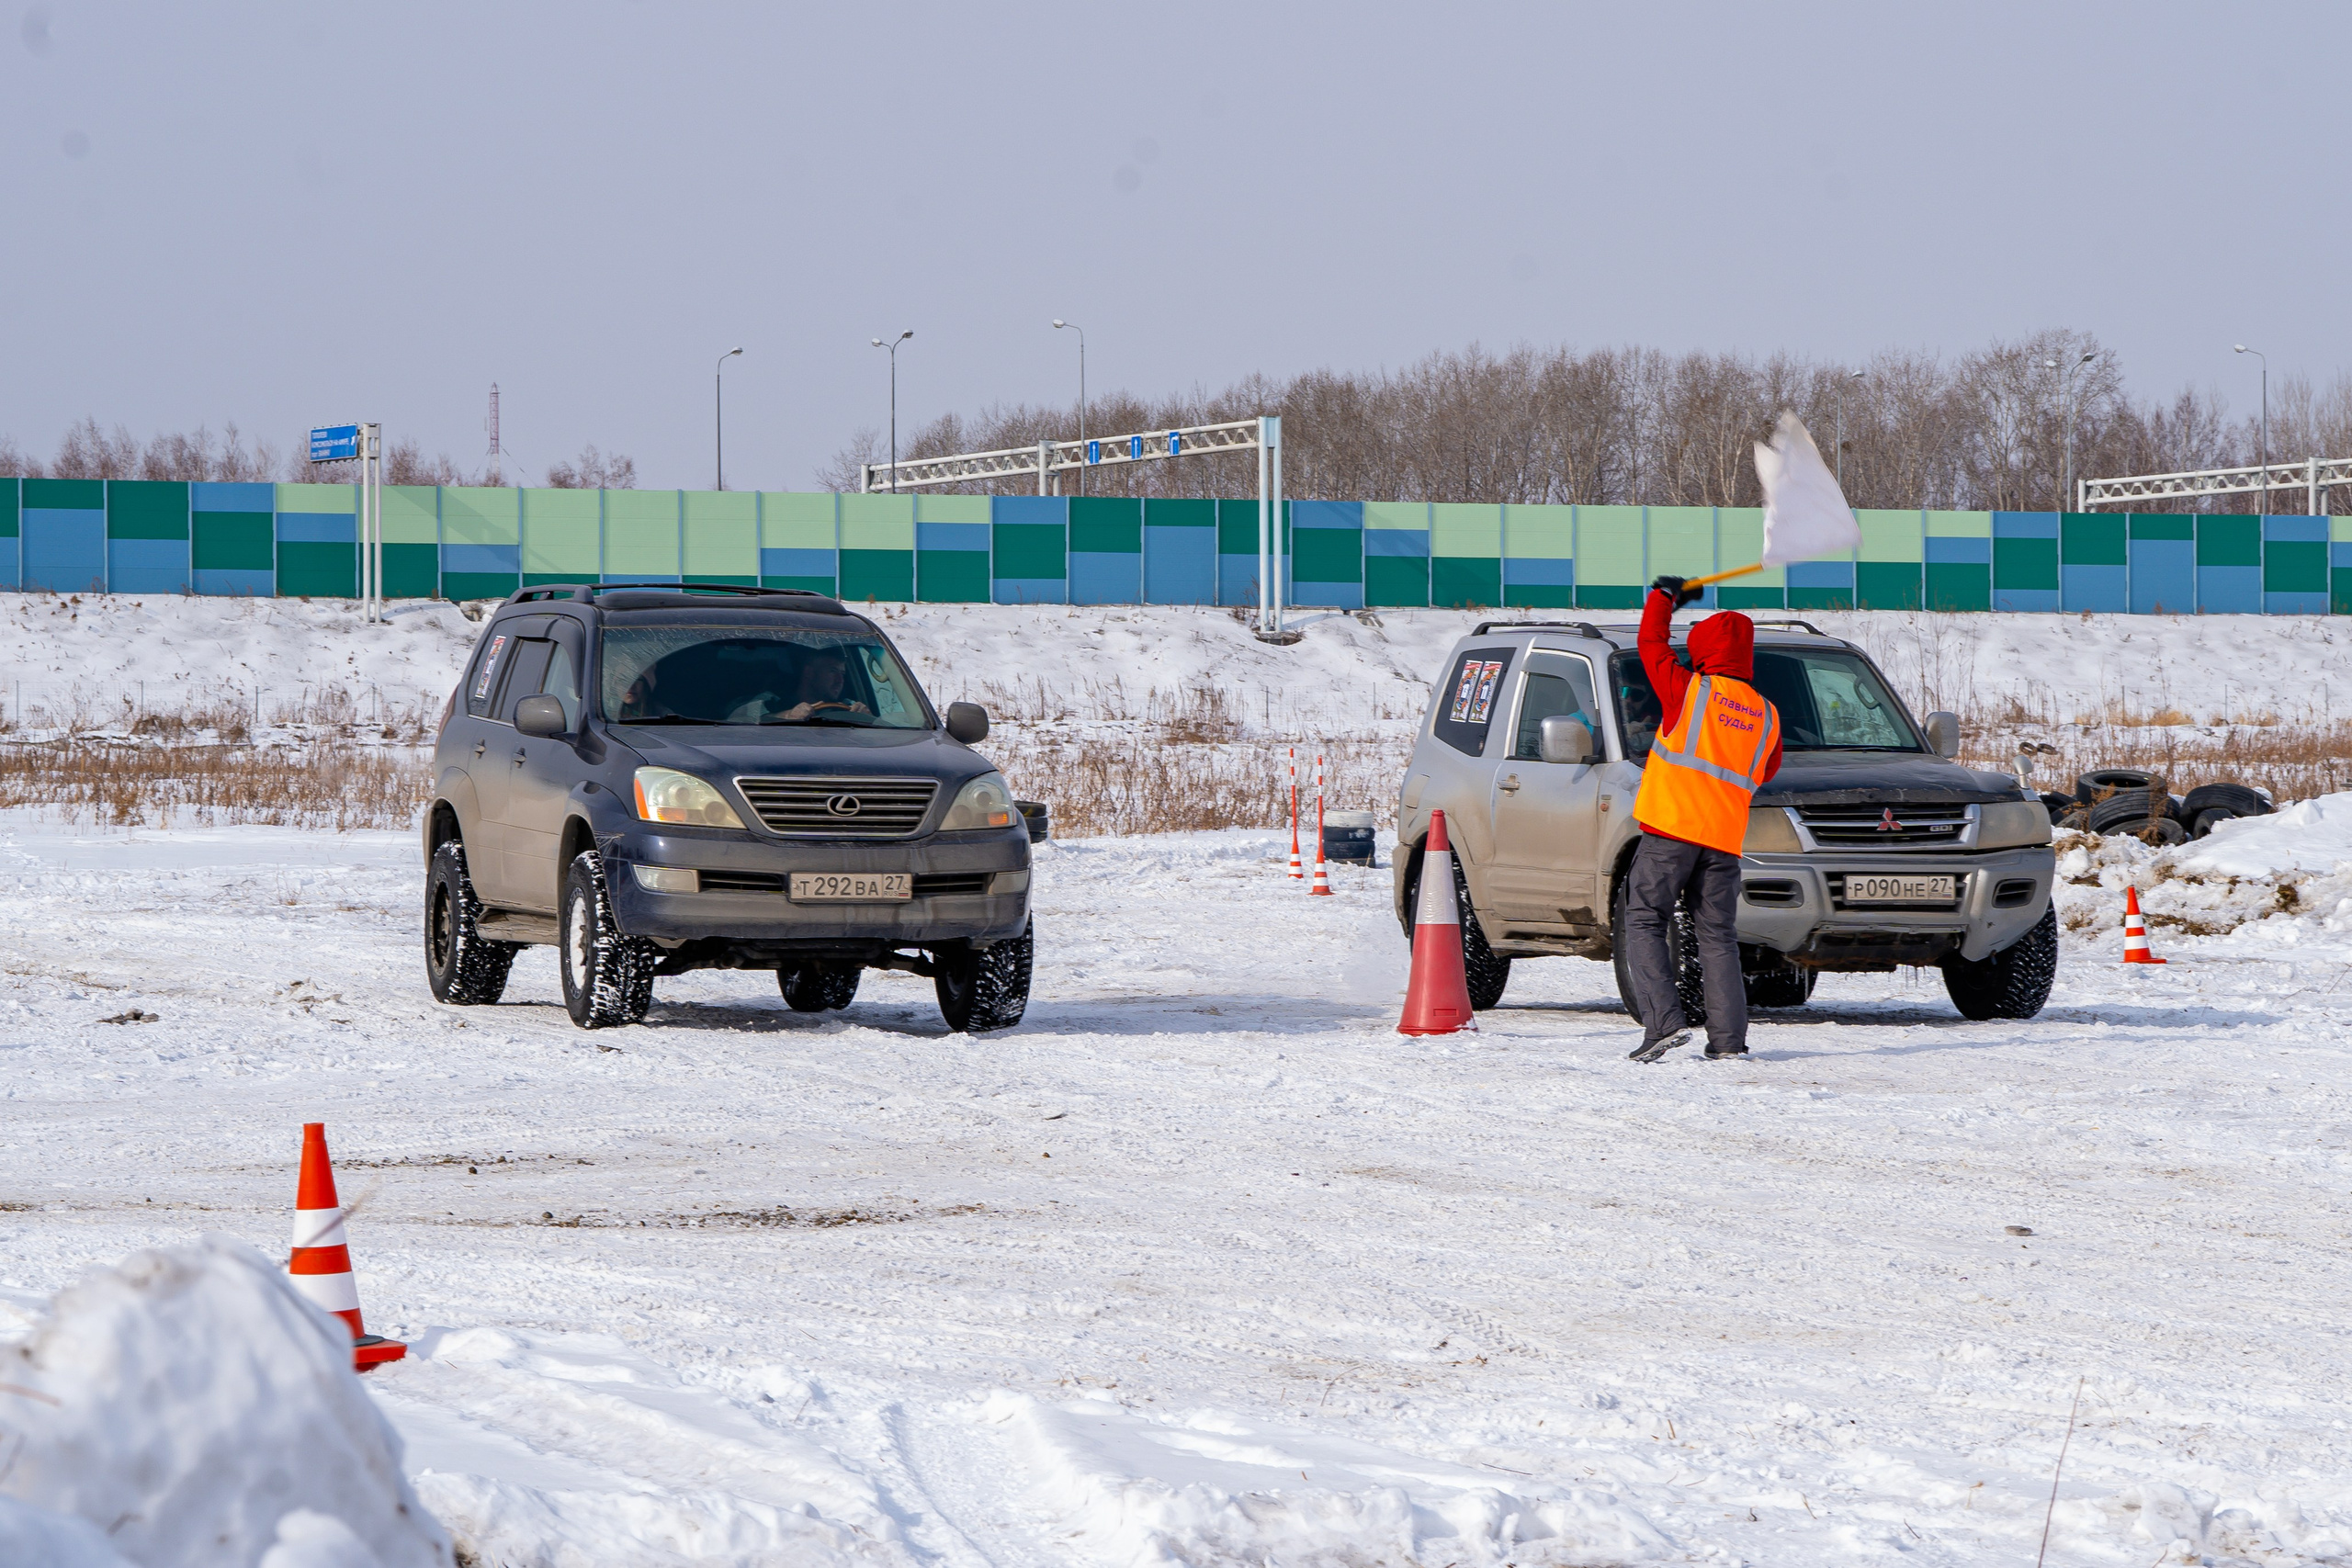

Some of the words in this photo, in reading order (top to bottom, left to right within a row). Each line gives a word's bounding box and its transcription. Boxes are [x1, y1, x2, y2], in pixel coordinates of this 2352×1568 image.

[1713, 692, 1763, 719] Главный
[1718, 713, 1754, 732] судья
[885, 875, 904, 890] 27
[1930, 878, 1948, 892] 27
